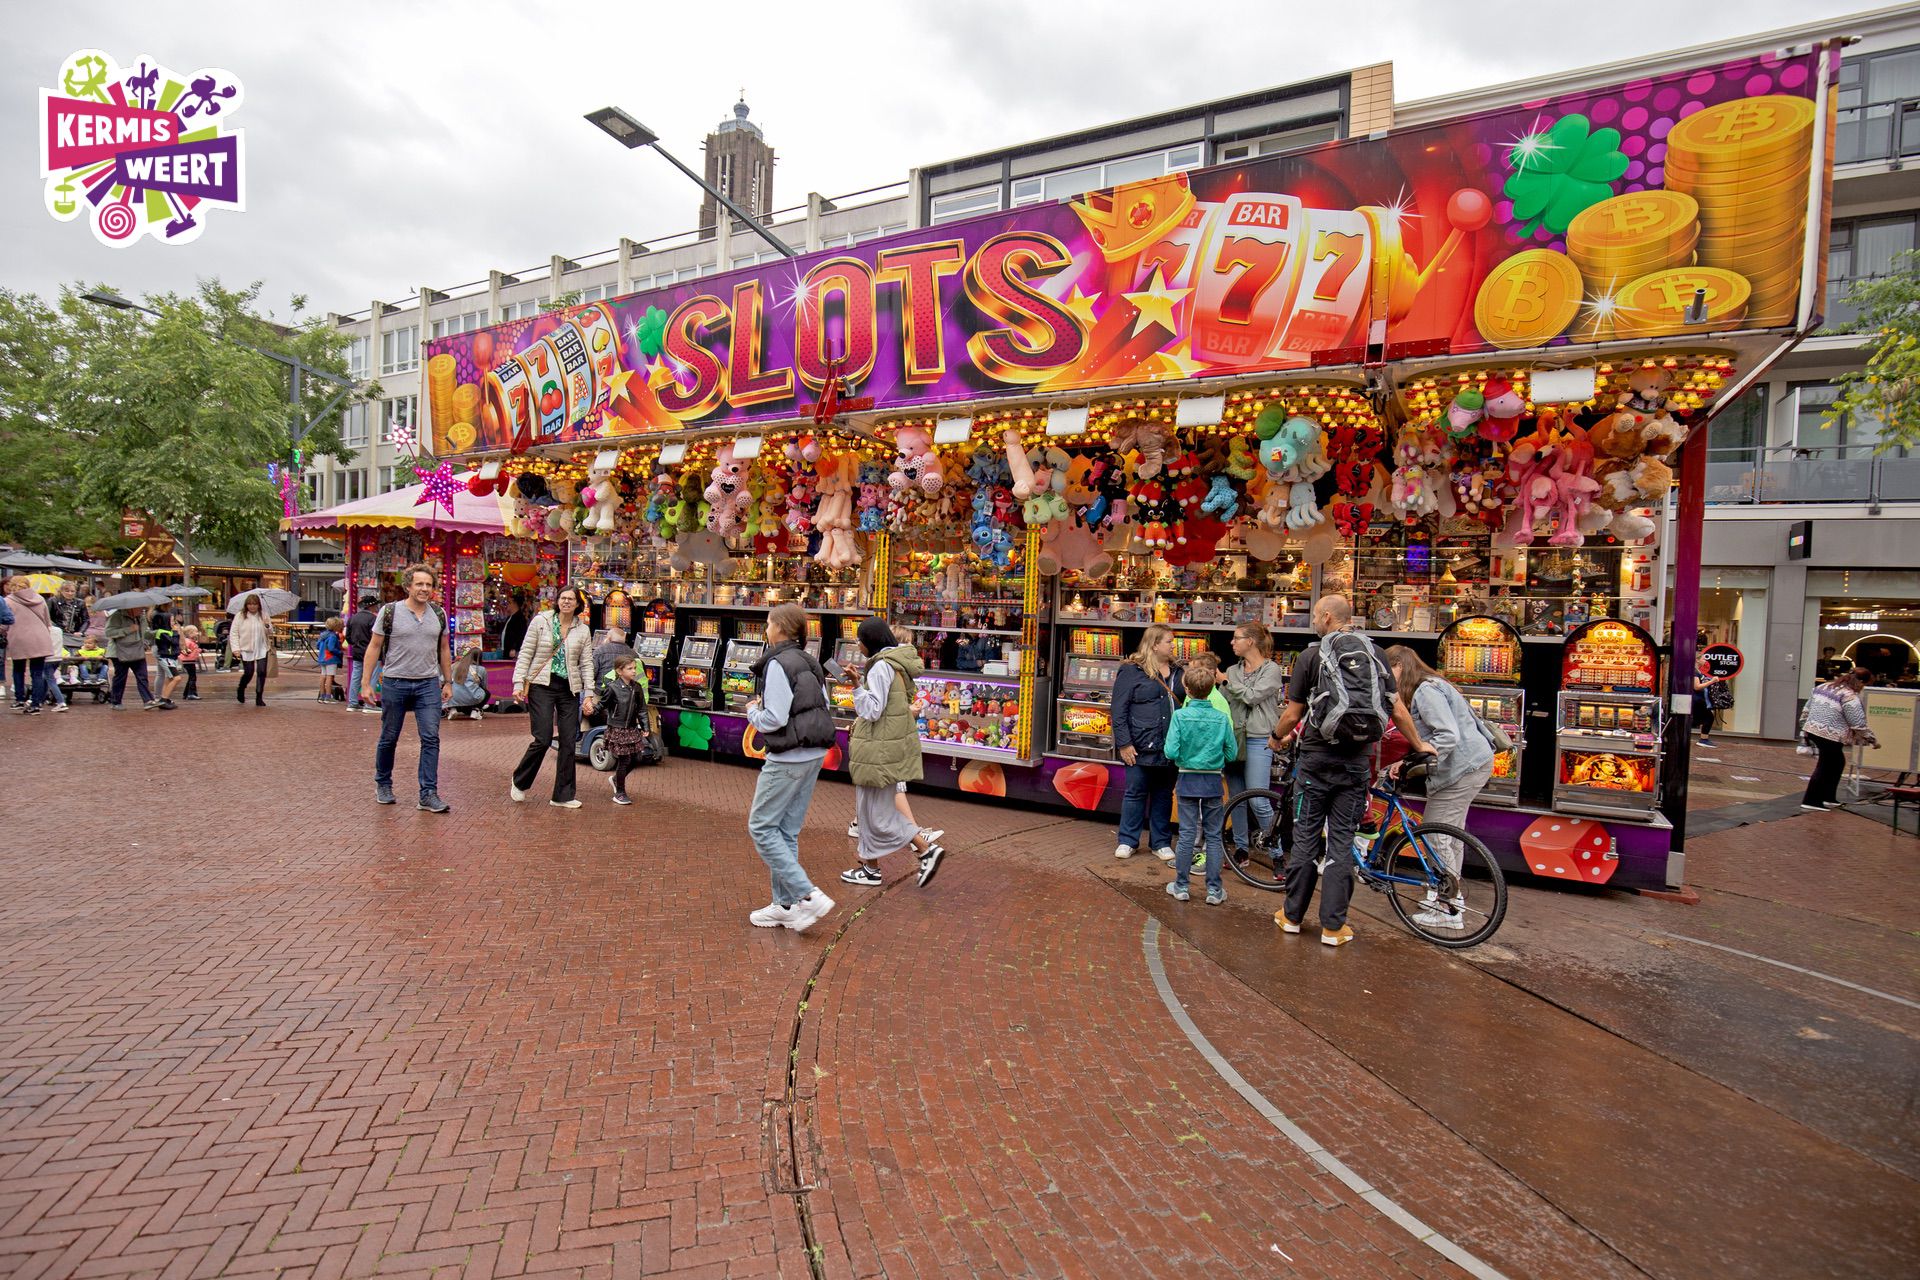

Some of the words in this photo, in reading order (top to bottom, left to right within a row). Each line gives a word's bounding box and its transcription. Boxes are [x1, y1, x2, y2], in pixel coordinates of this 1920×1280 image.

[1236, 204, 1282, 226] BAR
[1213, 235, 1291, 326] 7
[1313, 230, 1365, 301] 7
[655, 230, 1090, 421] SLOTS
[556, 332, 576, 348] BAR
[1206, 332, 1250, 354] BAR
[562, 343, 581, 359] BAR
[524, 345, 550, 378] 7
[566, 355, 585, 372] BAR
[501, 365, 520, 384] BAR
[507, 381, 530, 426] 7
[545, 418, 562, 435] BAR
[1703, 653, 1739, 661] OUTLET
